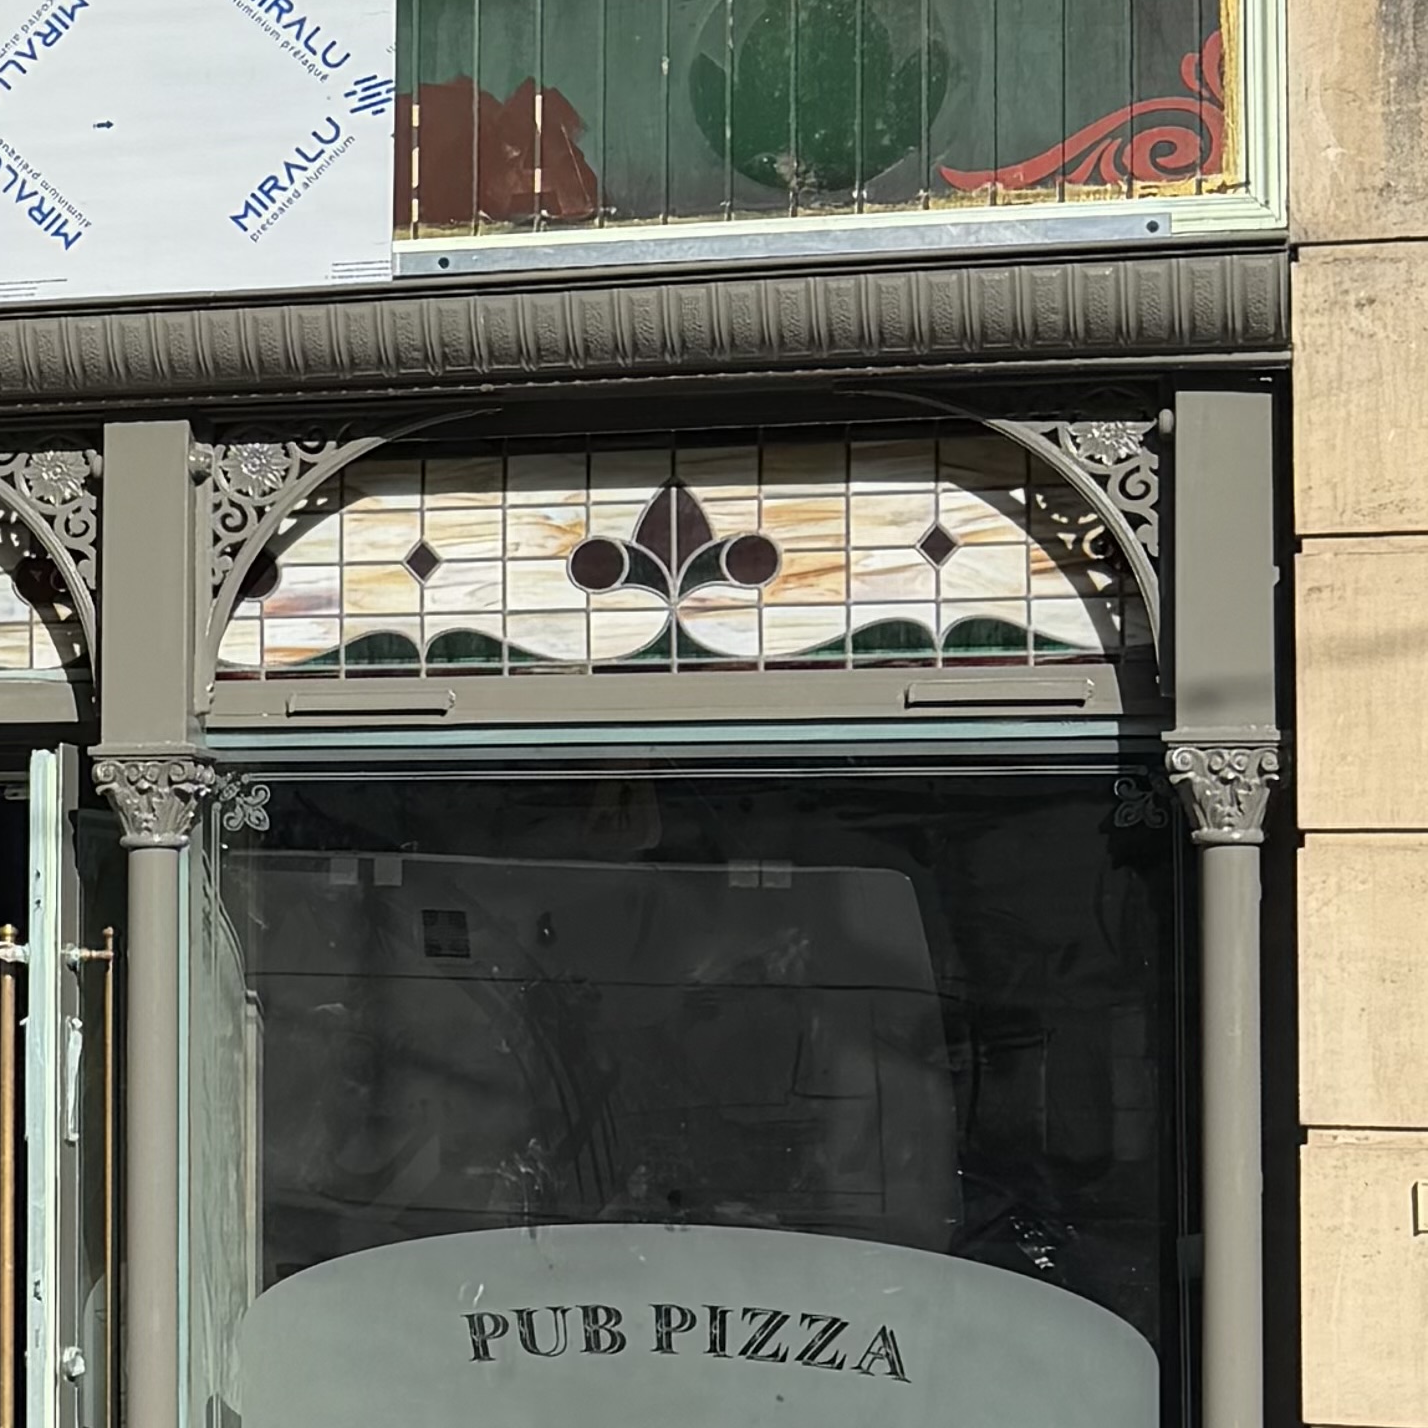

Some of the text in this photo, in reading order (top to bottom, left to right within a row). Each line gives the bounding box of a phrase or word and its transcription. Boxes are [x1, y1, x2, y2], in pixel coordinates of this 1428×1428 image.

[229, 116, 341, 232] MIRALU
[301, 135, 356, 190] aluminium
[460, 1303, 912, 1384] PUB PIZZA
